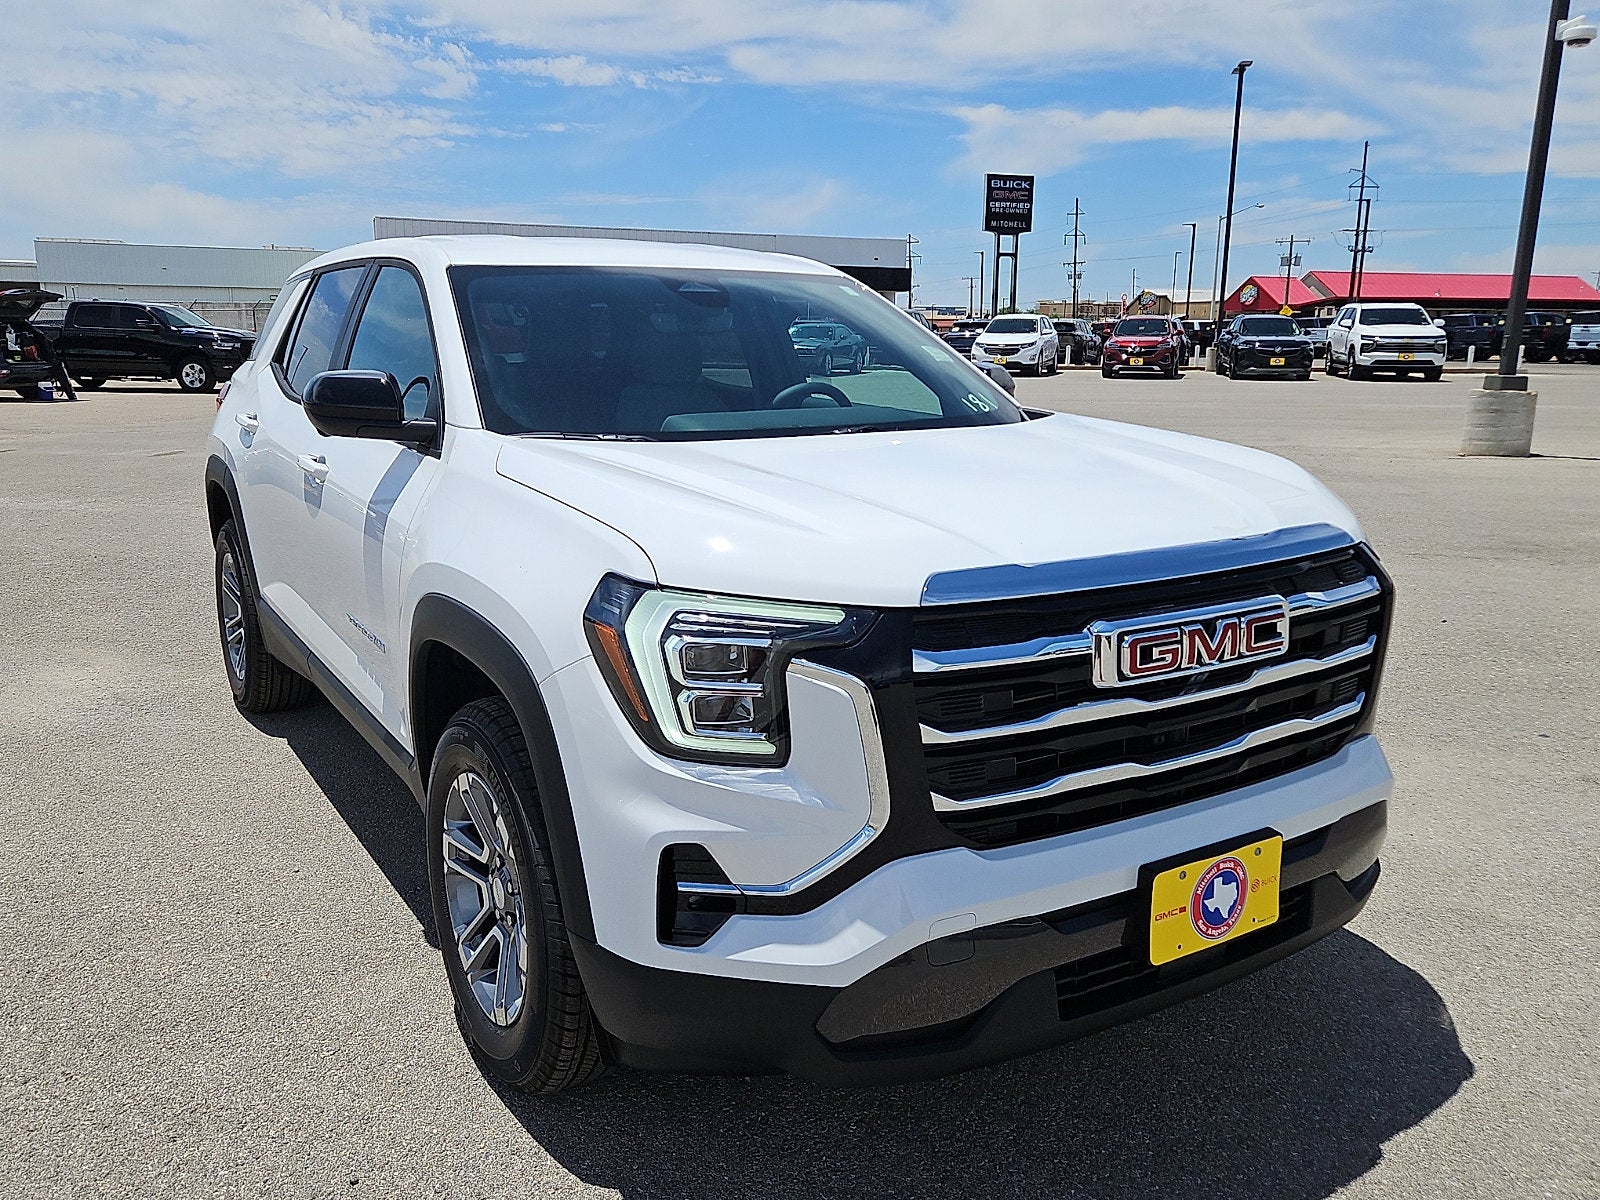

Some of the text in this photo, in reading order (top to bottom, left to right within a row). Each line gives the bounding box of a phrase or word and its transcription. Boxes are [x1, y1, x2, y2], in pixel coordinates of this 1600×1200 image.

[991, 180, 1030, 188] BUICK
[992, 191, 1028, 199] GMC
[961, 392, 999, 413] 181
[1121, 609, 1286, 678] GMC
[1196, 866, 1218, 895] Mitchell
[1154, 907, 1179, 921] GMC
